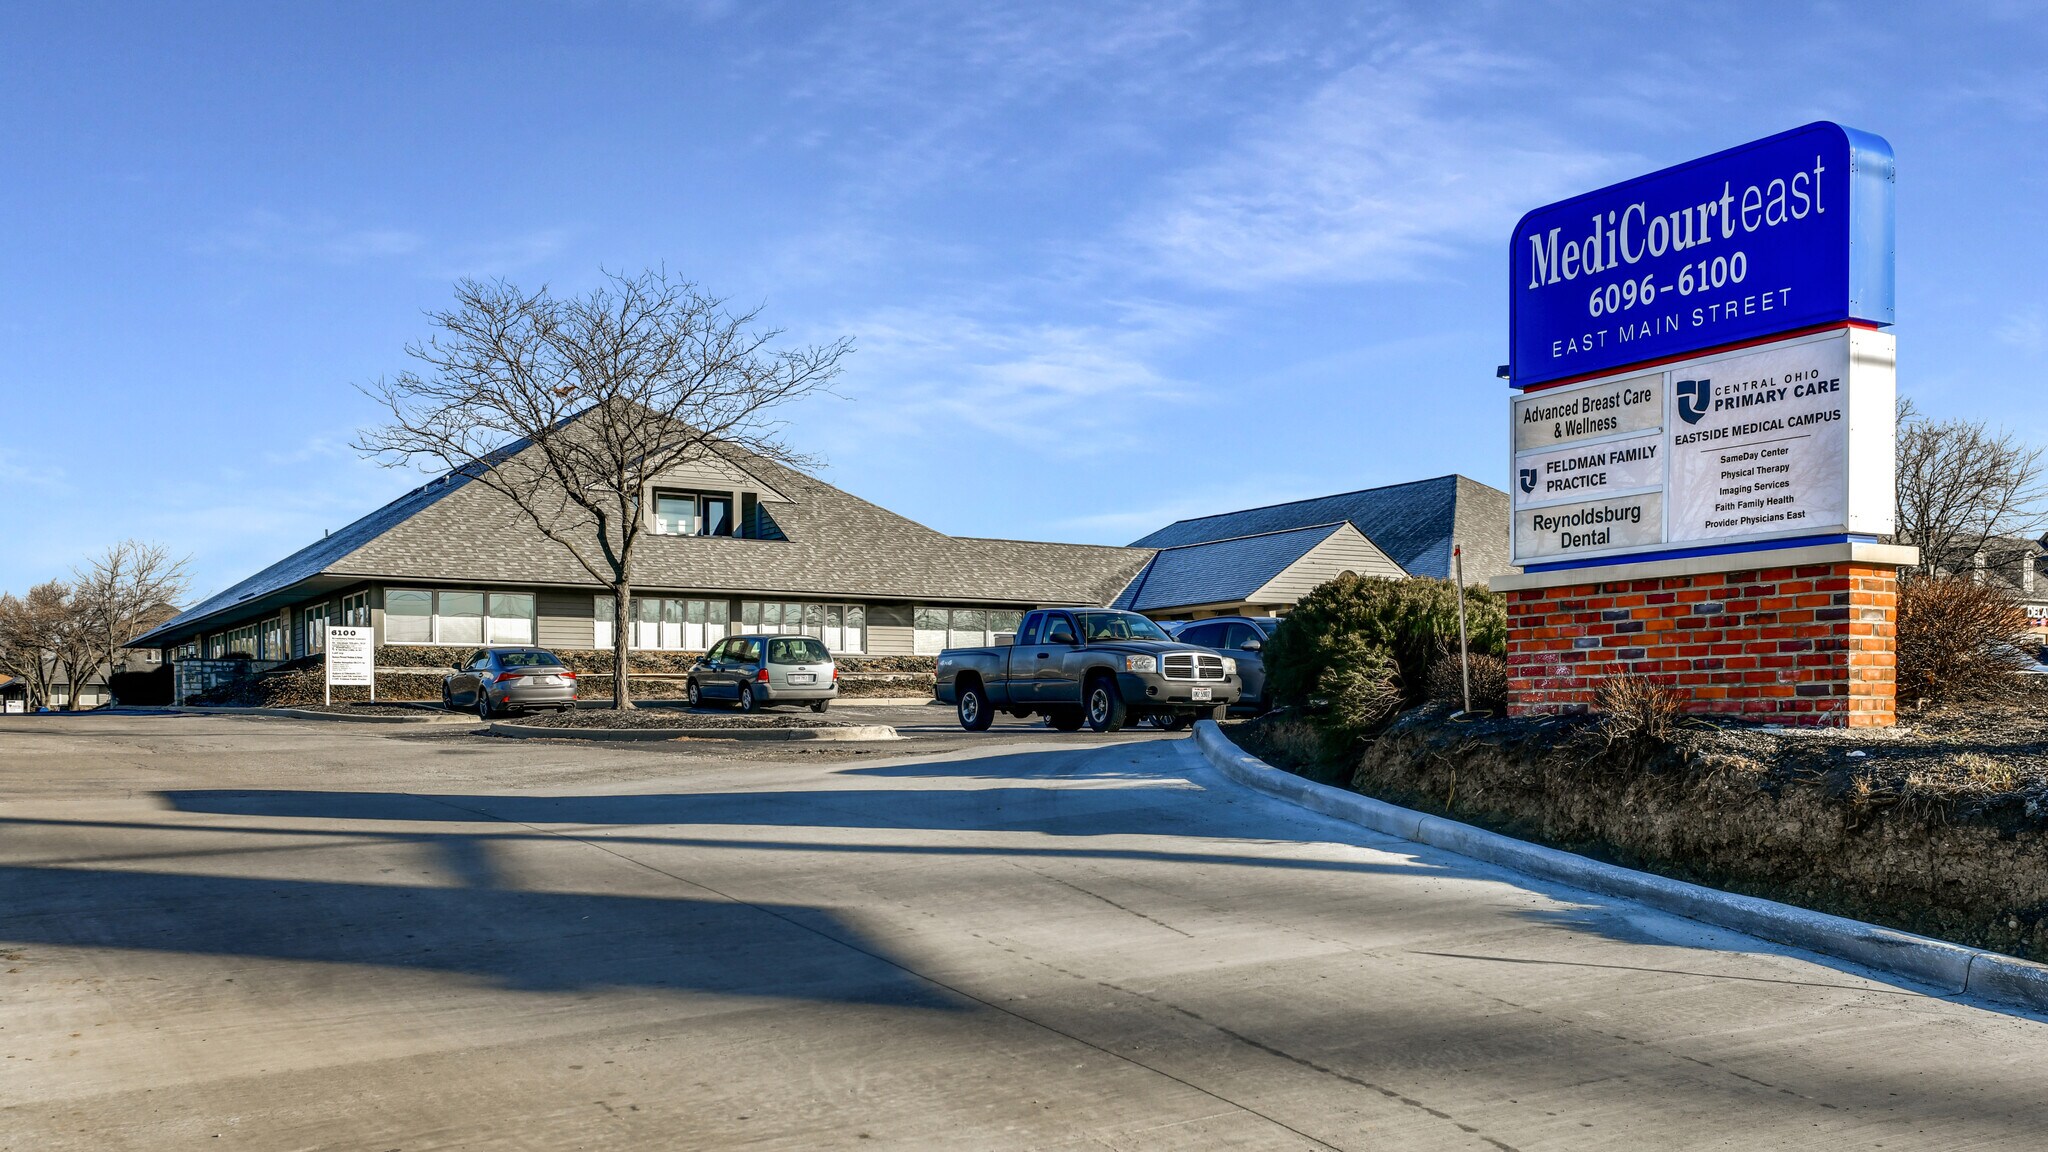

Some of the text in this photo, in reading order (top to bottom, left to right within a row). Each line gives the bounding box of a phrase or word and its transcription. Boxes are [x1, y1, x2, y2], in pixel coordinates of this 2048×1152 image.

[1589, 251, 1747, 317] 6096-6100
[1552, 287, 1792, 358] EAST MAIN STREET
[1715, 369, 1819, 396] CENTRAL OHIO
[1523, 389, 1652, 424] Advanced Breast Care
[1714, 378, 1840, 412] PRIMARY CARE
[1554, 416, 1617, 438] & Wellness
[1675, 409, 1841, 445] EASTSIDE MEDICAL CAMPUS
[1546, 445, 1657, 474] FELDMAN FAMILY
[1720, 447, 1789, 464] SameDay Center
[1546, 472, 1607, 492] PRACTICE
[1721, 464, 1790, 479] Physical Therapy
[1719, 480, 1790, 495] Imaging Services
[1715, 495, 1795, 512] Faith Family Health
[1533, 506, 1641, 533] Reynoldsburg
[1705, 510, 1806, 528] Provider Physicians East
[1561, 527, 1610, 548] Dental
